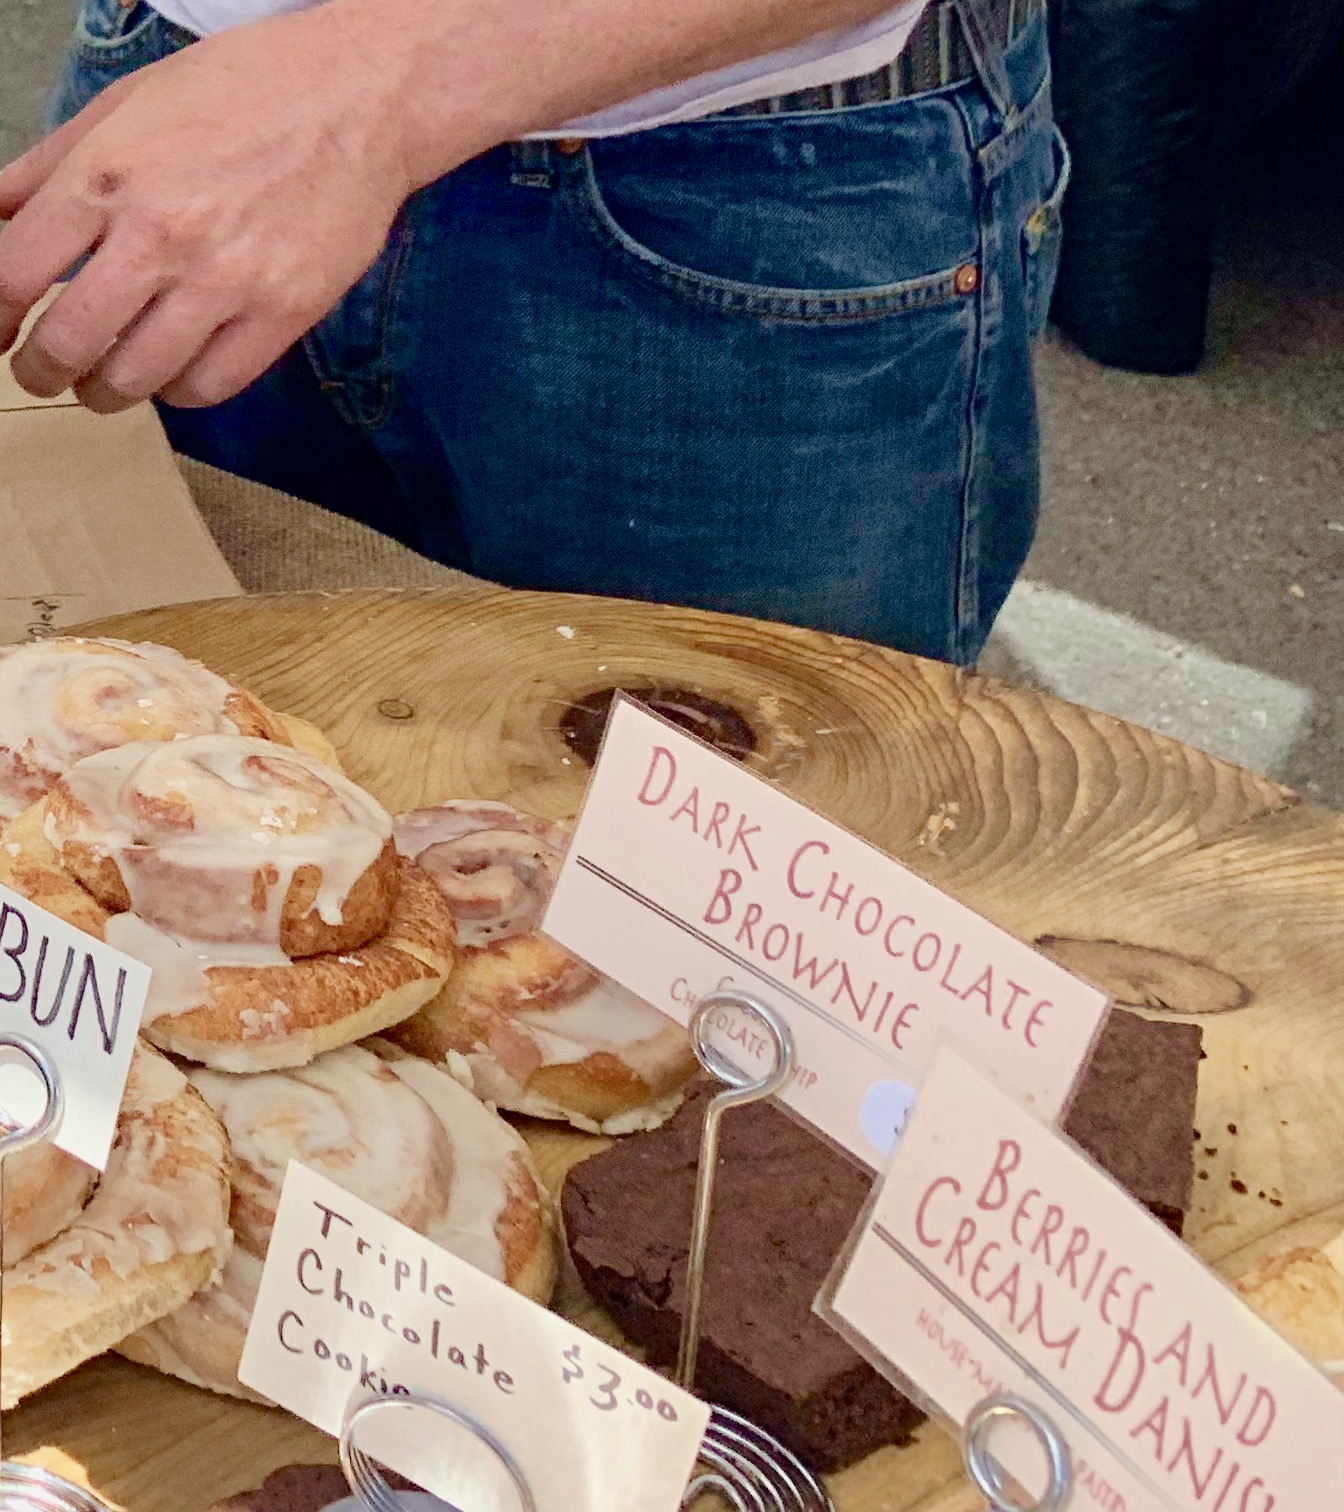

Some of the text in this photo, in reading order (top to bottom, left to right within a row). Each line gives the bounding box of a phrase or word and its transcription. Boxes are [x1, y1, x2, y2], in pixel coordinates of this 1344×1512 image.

[637, 745, 1055, 1049] DARK CHOCOLATE
[703, 867, 920, 1051] BROWNIE
[297, 1248, 515, 1395] Chocolate
[313, 1200, 455, 1307] Triple
[915, 1177, 1080, 1369] CREAM
[976, 1138, 1278, 1448] BERRIES AND
[562, 1344, 678, 1422] $3.00
